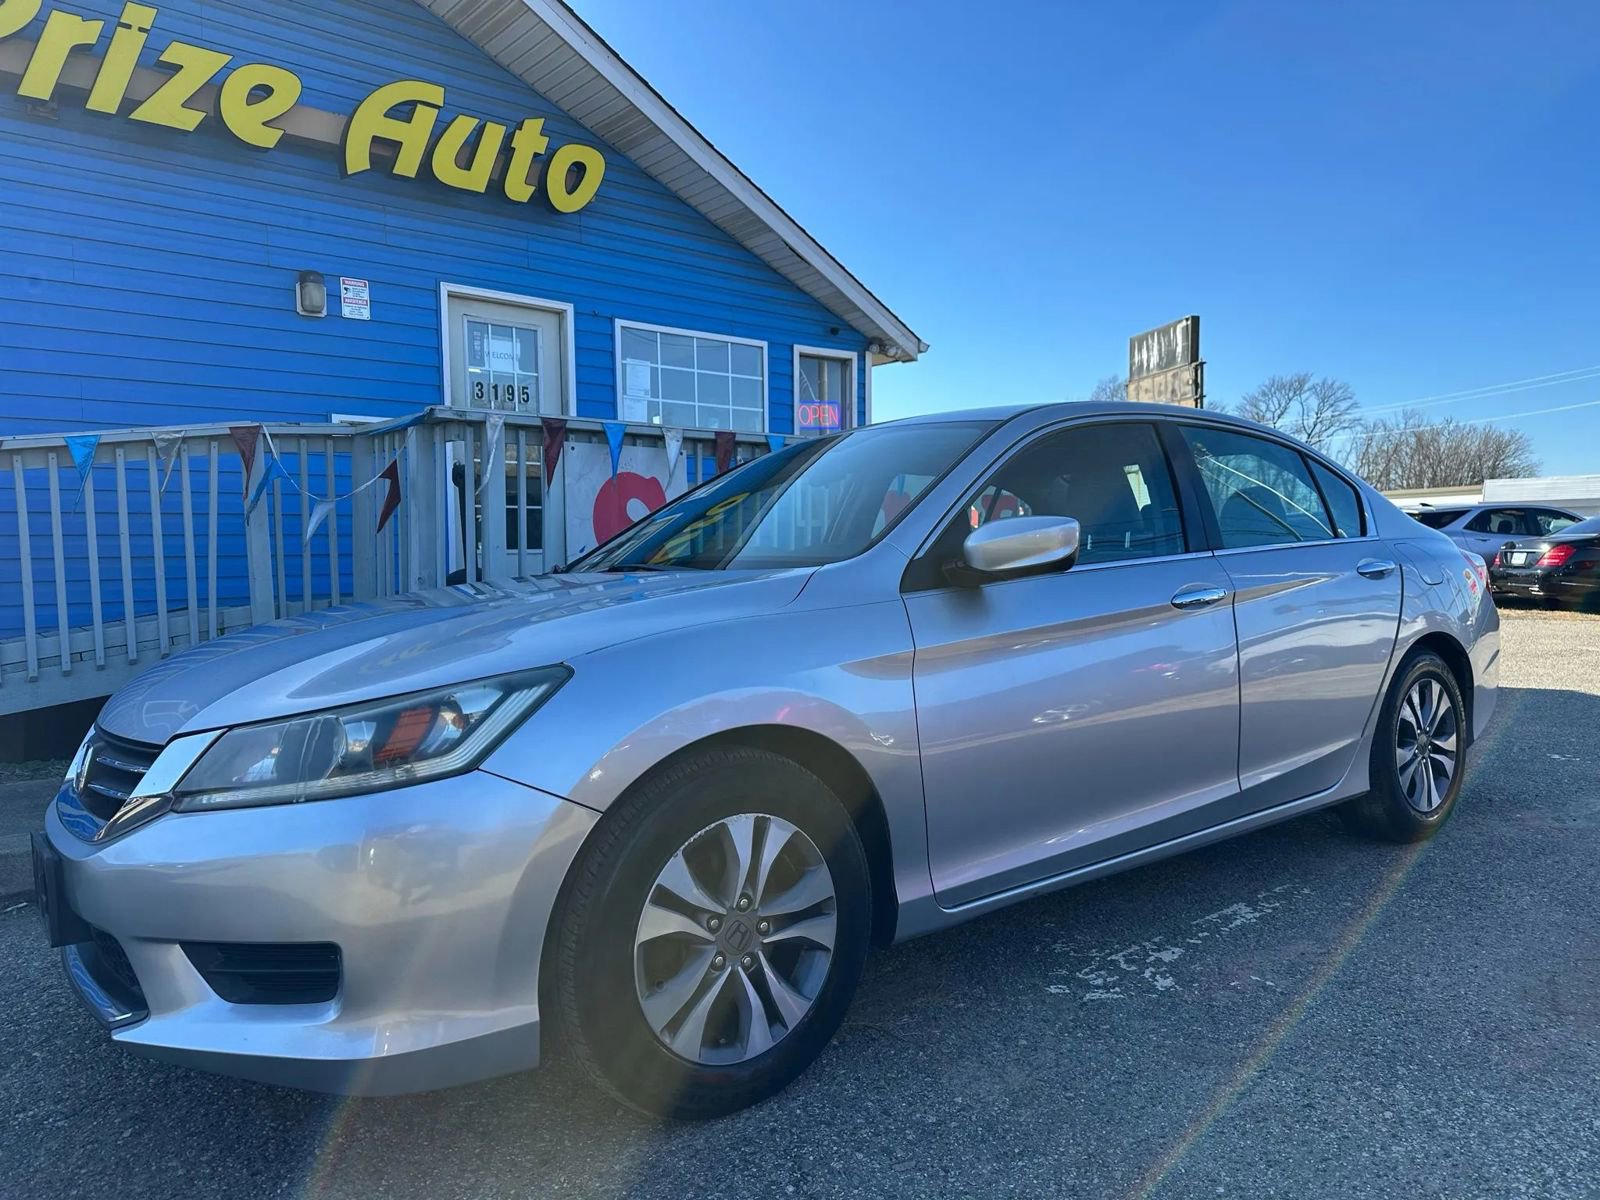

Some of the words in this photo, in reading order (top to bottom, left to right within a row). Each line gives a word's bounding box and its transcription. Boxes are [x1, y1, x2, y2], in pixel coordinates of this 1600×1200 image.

[0, 0, 303, 149] rize
[345, 80, 606, 213] Auto
[475, 382, 530, 403] 3195
[798, 404, 840, 425] OPEN
